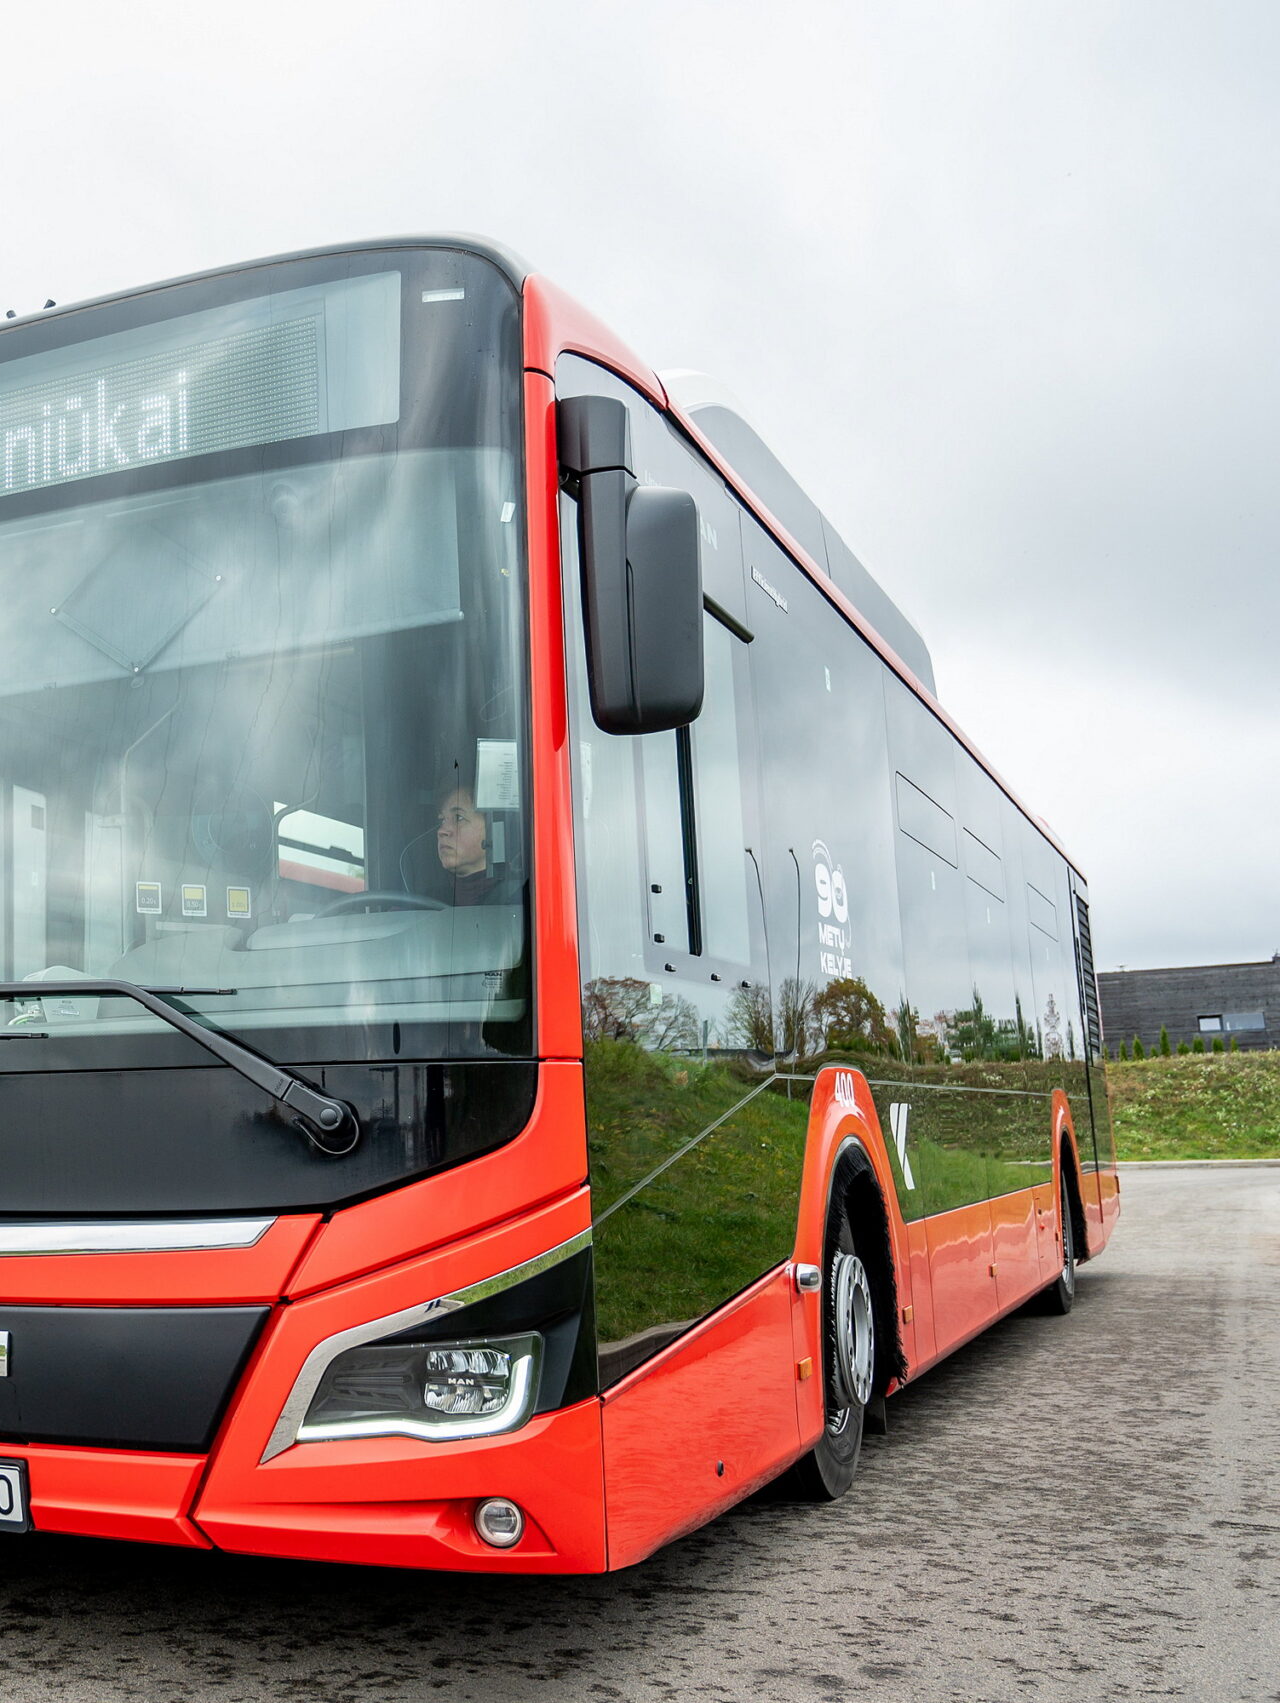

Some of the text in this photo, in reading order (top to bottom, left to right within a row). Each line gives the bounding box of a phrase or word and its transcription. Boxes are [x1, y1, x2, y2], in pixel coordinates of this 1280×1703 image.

[700, 515, 718, 551] AN
[815, 863, 848, 923] 90
[819, 922, 845, 957] METŲ
[835, 1072, 855, 1107] 400
[448, 1378, 474, 1386] MAN
